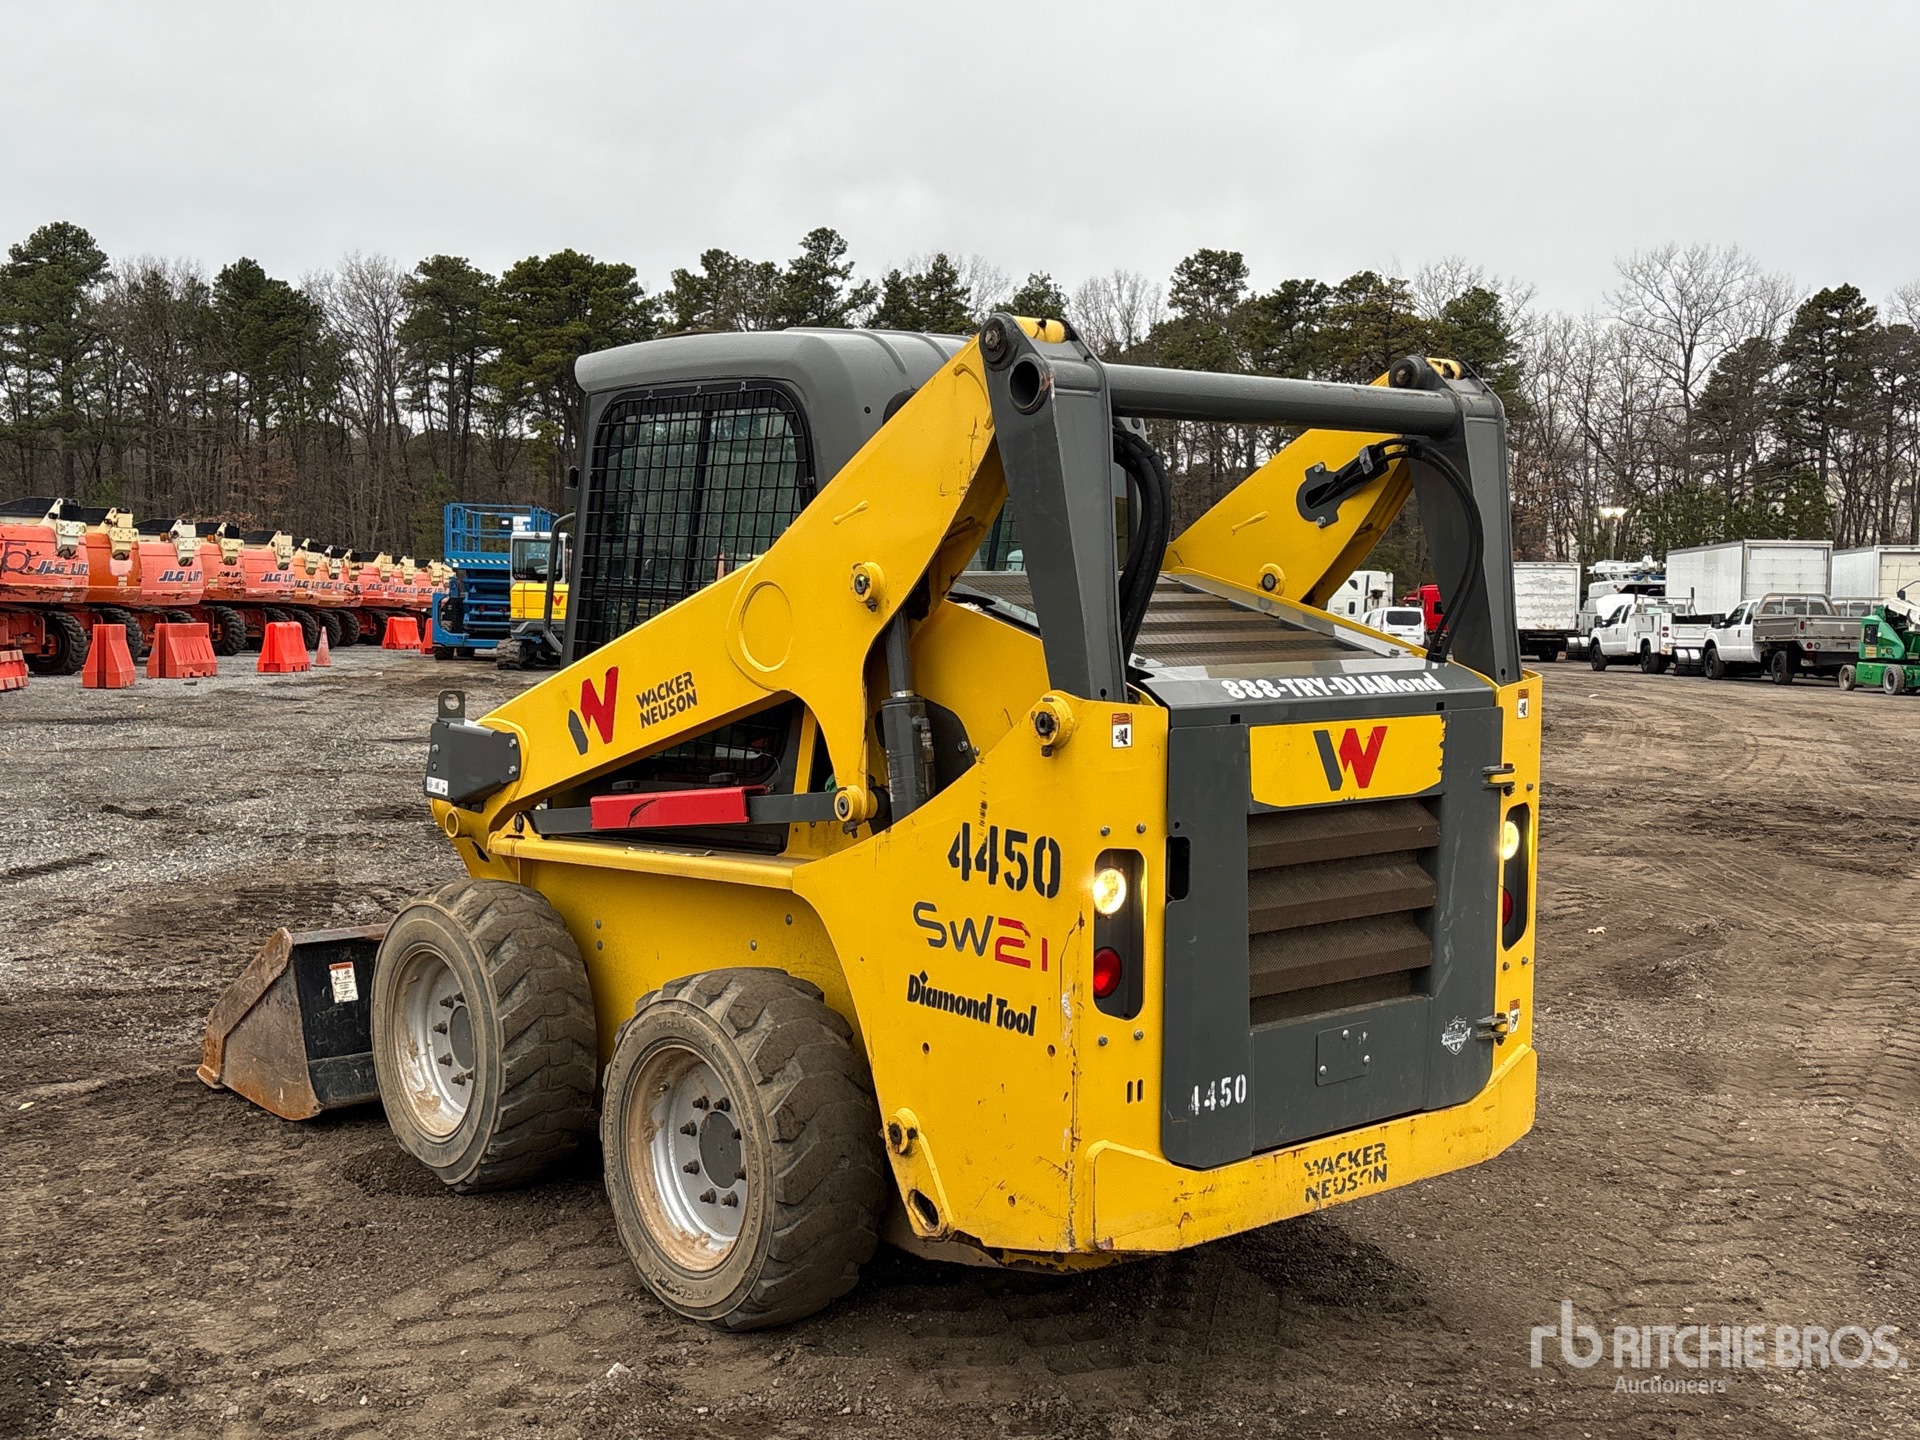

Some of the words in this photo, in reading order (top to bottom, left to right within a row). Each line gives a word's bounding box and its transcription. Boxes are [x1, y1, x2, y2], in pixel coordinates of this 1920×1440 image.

[36, 560, 67, 575] JLG
[159, 570, 185, 582] JLG
[261, 573, 282, 583] JLG
[365, 583, 382, 591] JLG
[636, 671, 695, 710] WACKER
[1220, 671, 1446, 699] 888-TRY-DIAMond
[639, 689, 698, 729] NEUSON
[947, 821, 1061, 899] 4450
[912, 901, 1048, 973] SW21
[907, 970, 993, 1024] Diamond
[996, 997, 1037, 1037] Tool
[1188, 1073, 1247, 1116] 4450
[1303, 1142, 1388, 1177] WACKER
[1305, 1163, 1388, 1203] NEUSON
